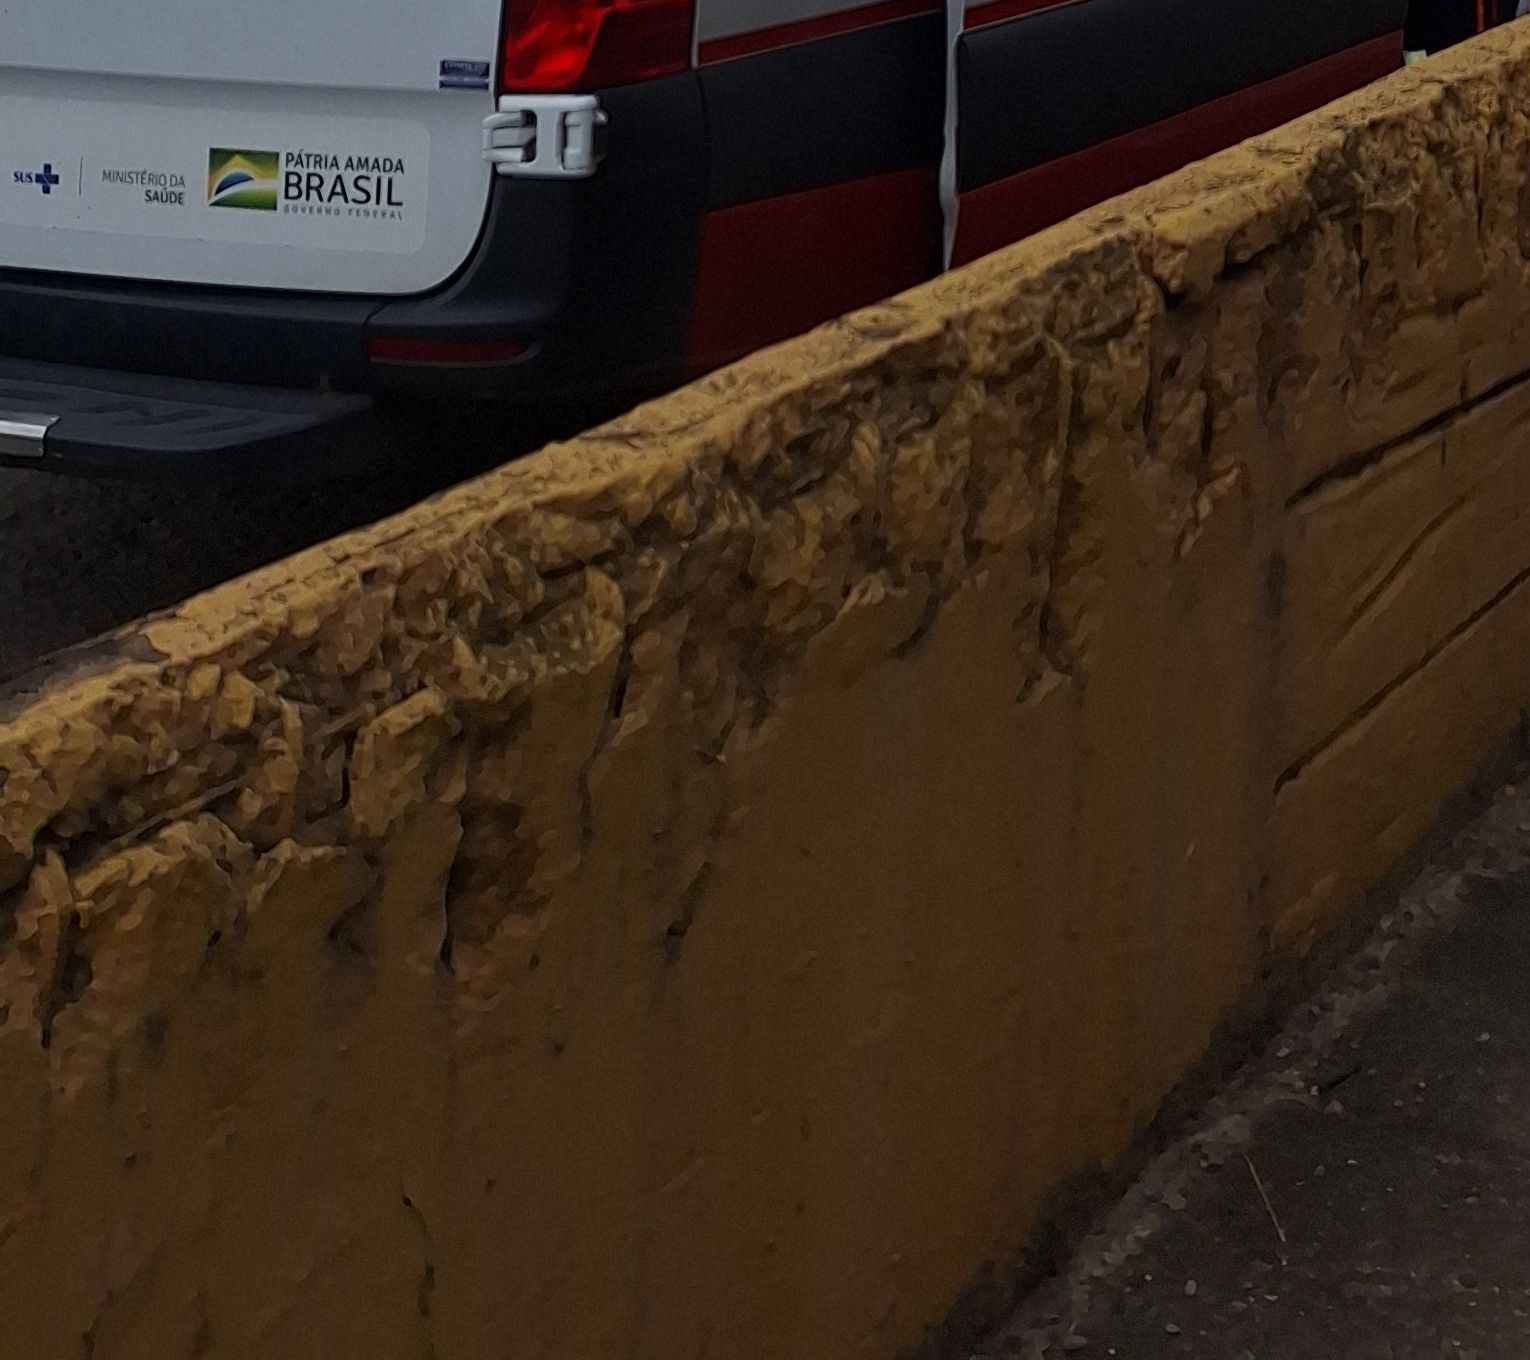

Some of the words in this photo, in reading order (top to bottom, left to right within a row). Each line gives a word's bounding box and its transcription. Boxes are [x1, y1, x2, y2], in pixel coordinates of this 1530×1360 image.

[285, 148, 340, 171] PÁTRIA
[344, 156, 405, 175] AMADA
[13, 171, 34, 184] SUS
[102, 168, 167, 188] MINISTÉRIO
[169, 174, 186, 189] DA
[144, 188, 185, 205] SAÚDE
[284, 171, 404, 207] BRASIL
